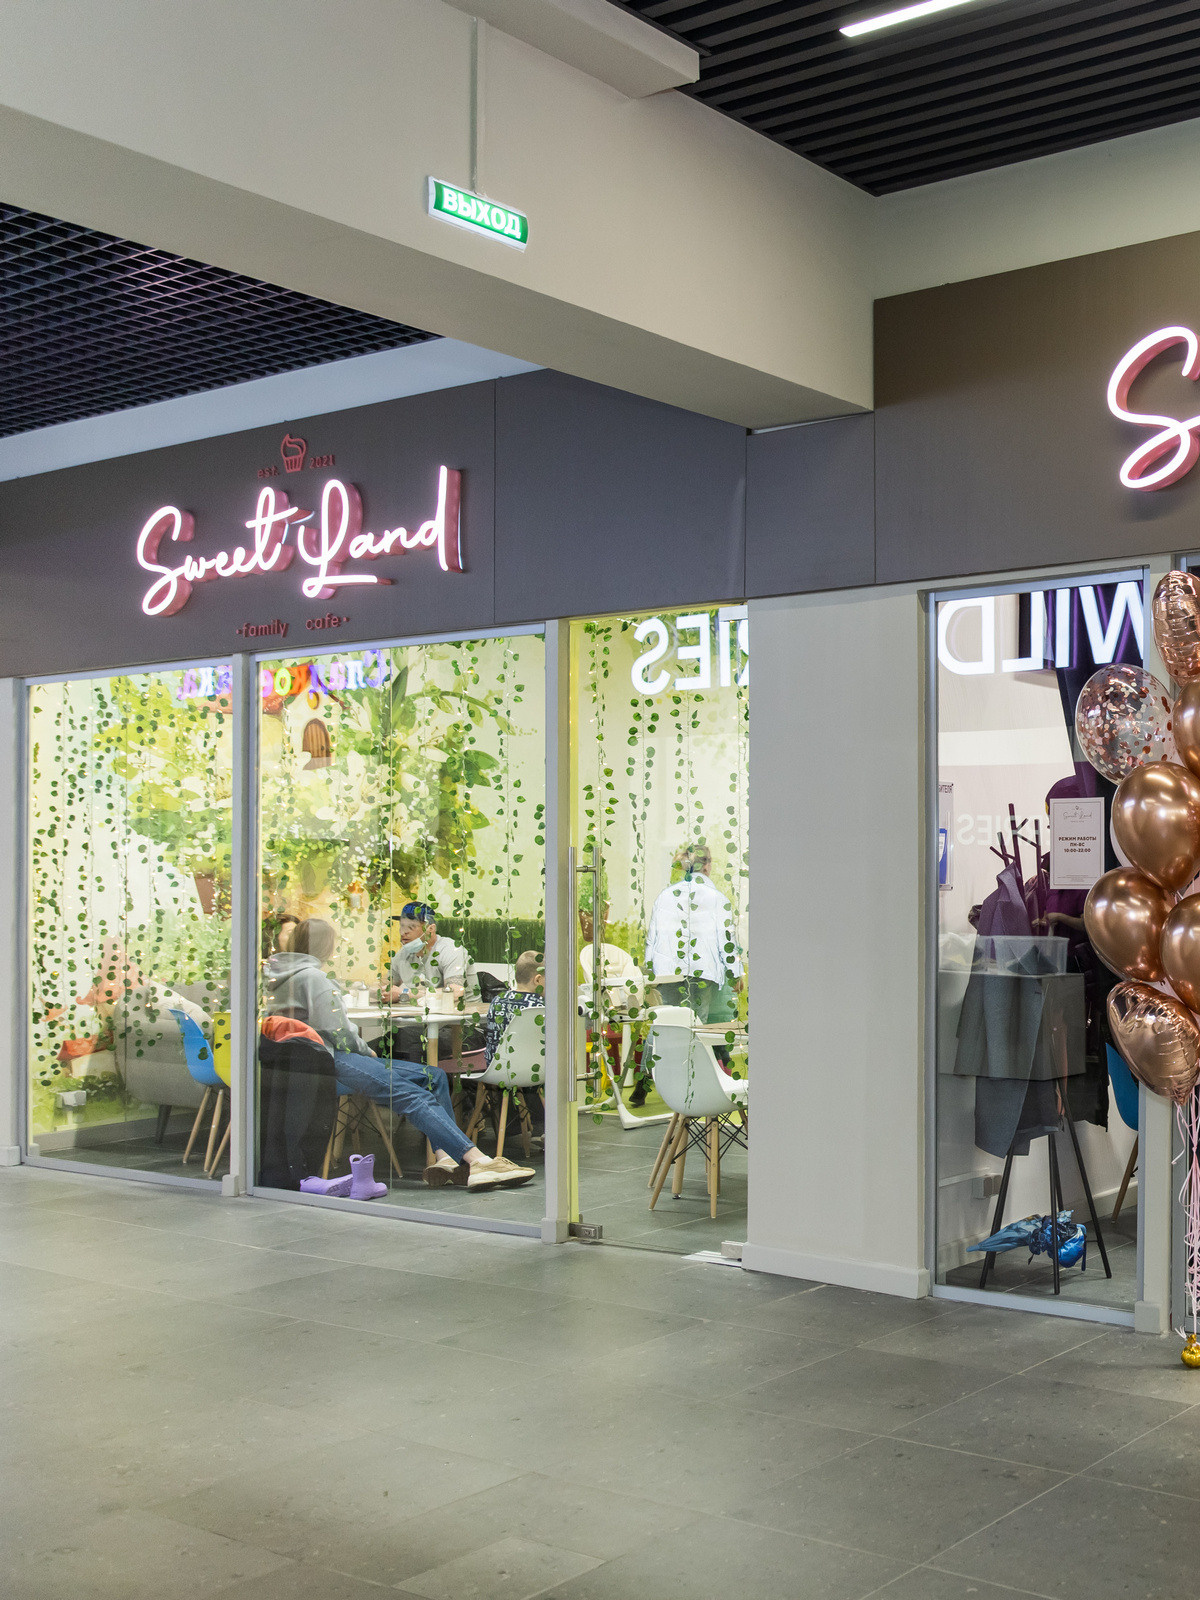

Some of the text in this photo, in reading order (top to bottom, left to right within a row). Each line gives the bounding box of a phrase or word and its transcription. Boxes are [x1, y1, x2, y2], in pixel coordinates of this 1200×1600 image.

[442, 186, 521, 239] ВЫХОД
[256, 454, 336, 479] est. 2021
[137, 464, 463, 617] Sweet Land
